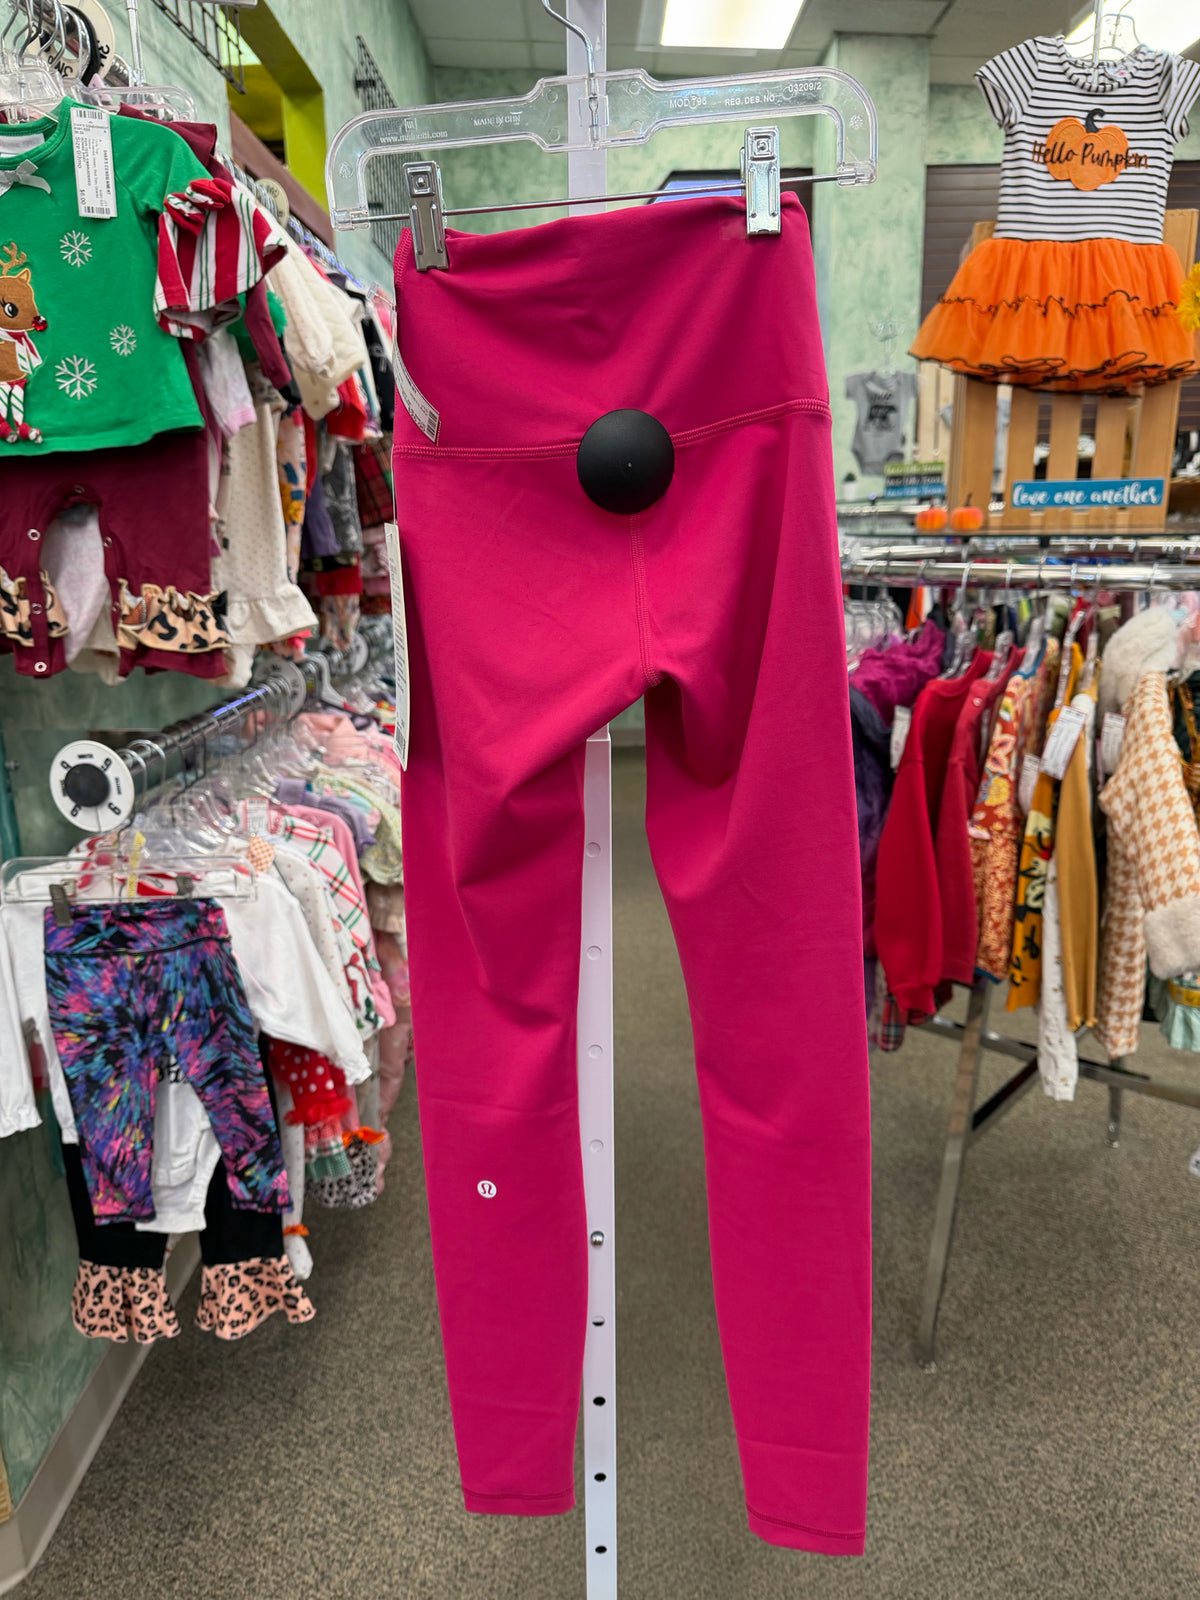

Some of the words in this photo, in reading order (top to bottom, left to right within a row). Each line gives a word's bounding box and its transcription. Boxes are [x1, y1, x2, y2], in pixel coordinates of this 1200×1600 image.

[1032, 140, 1078, 164] Hello
[1081, 142, 1149, 172] Pumpkin
[1013, 485, 1050, 505] love
[1054, 490, 1087, 505] one
[1090, 482, 1161, 505] another
